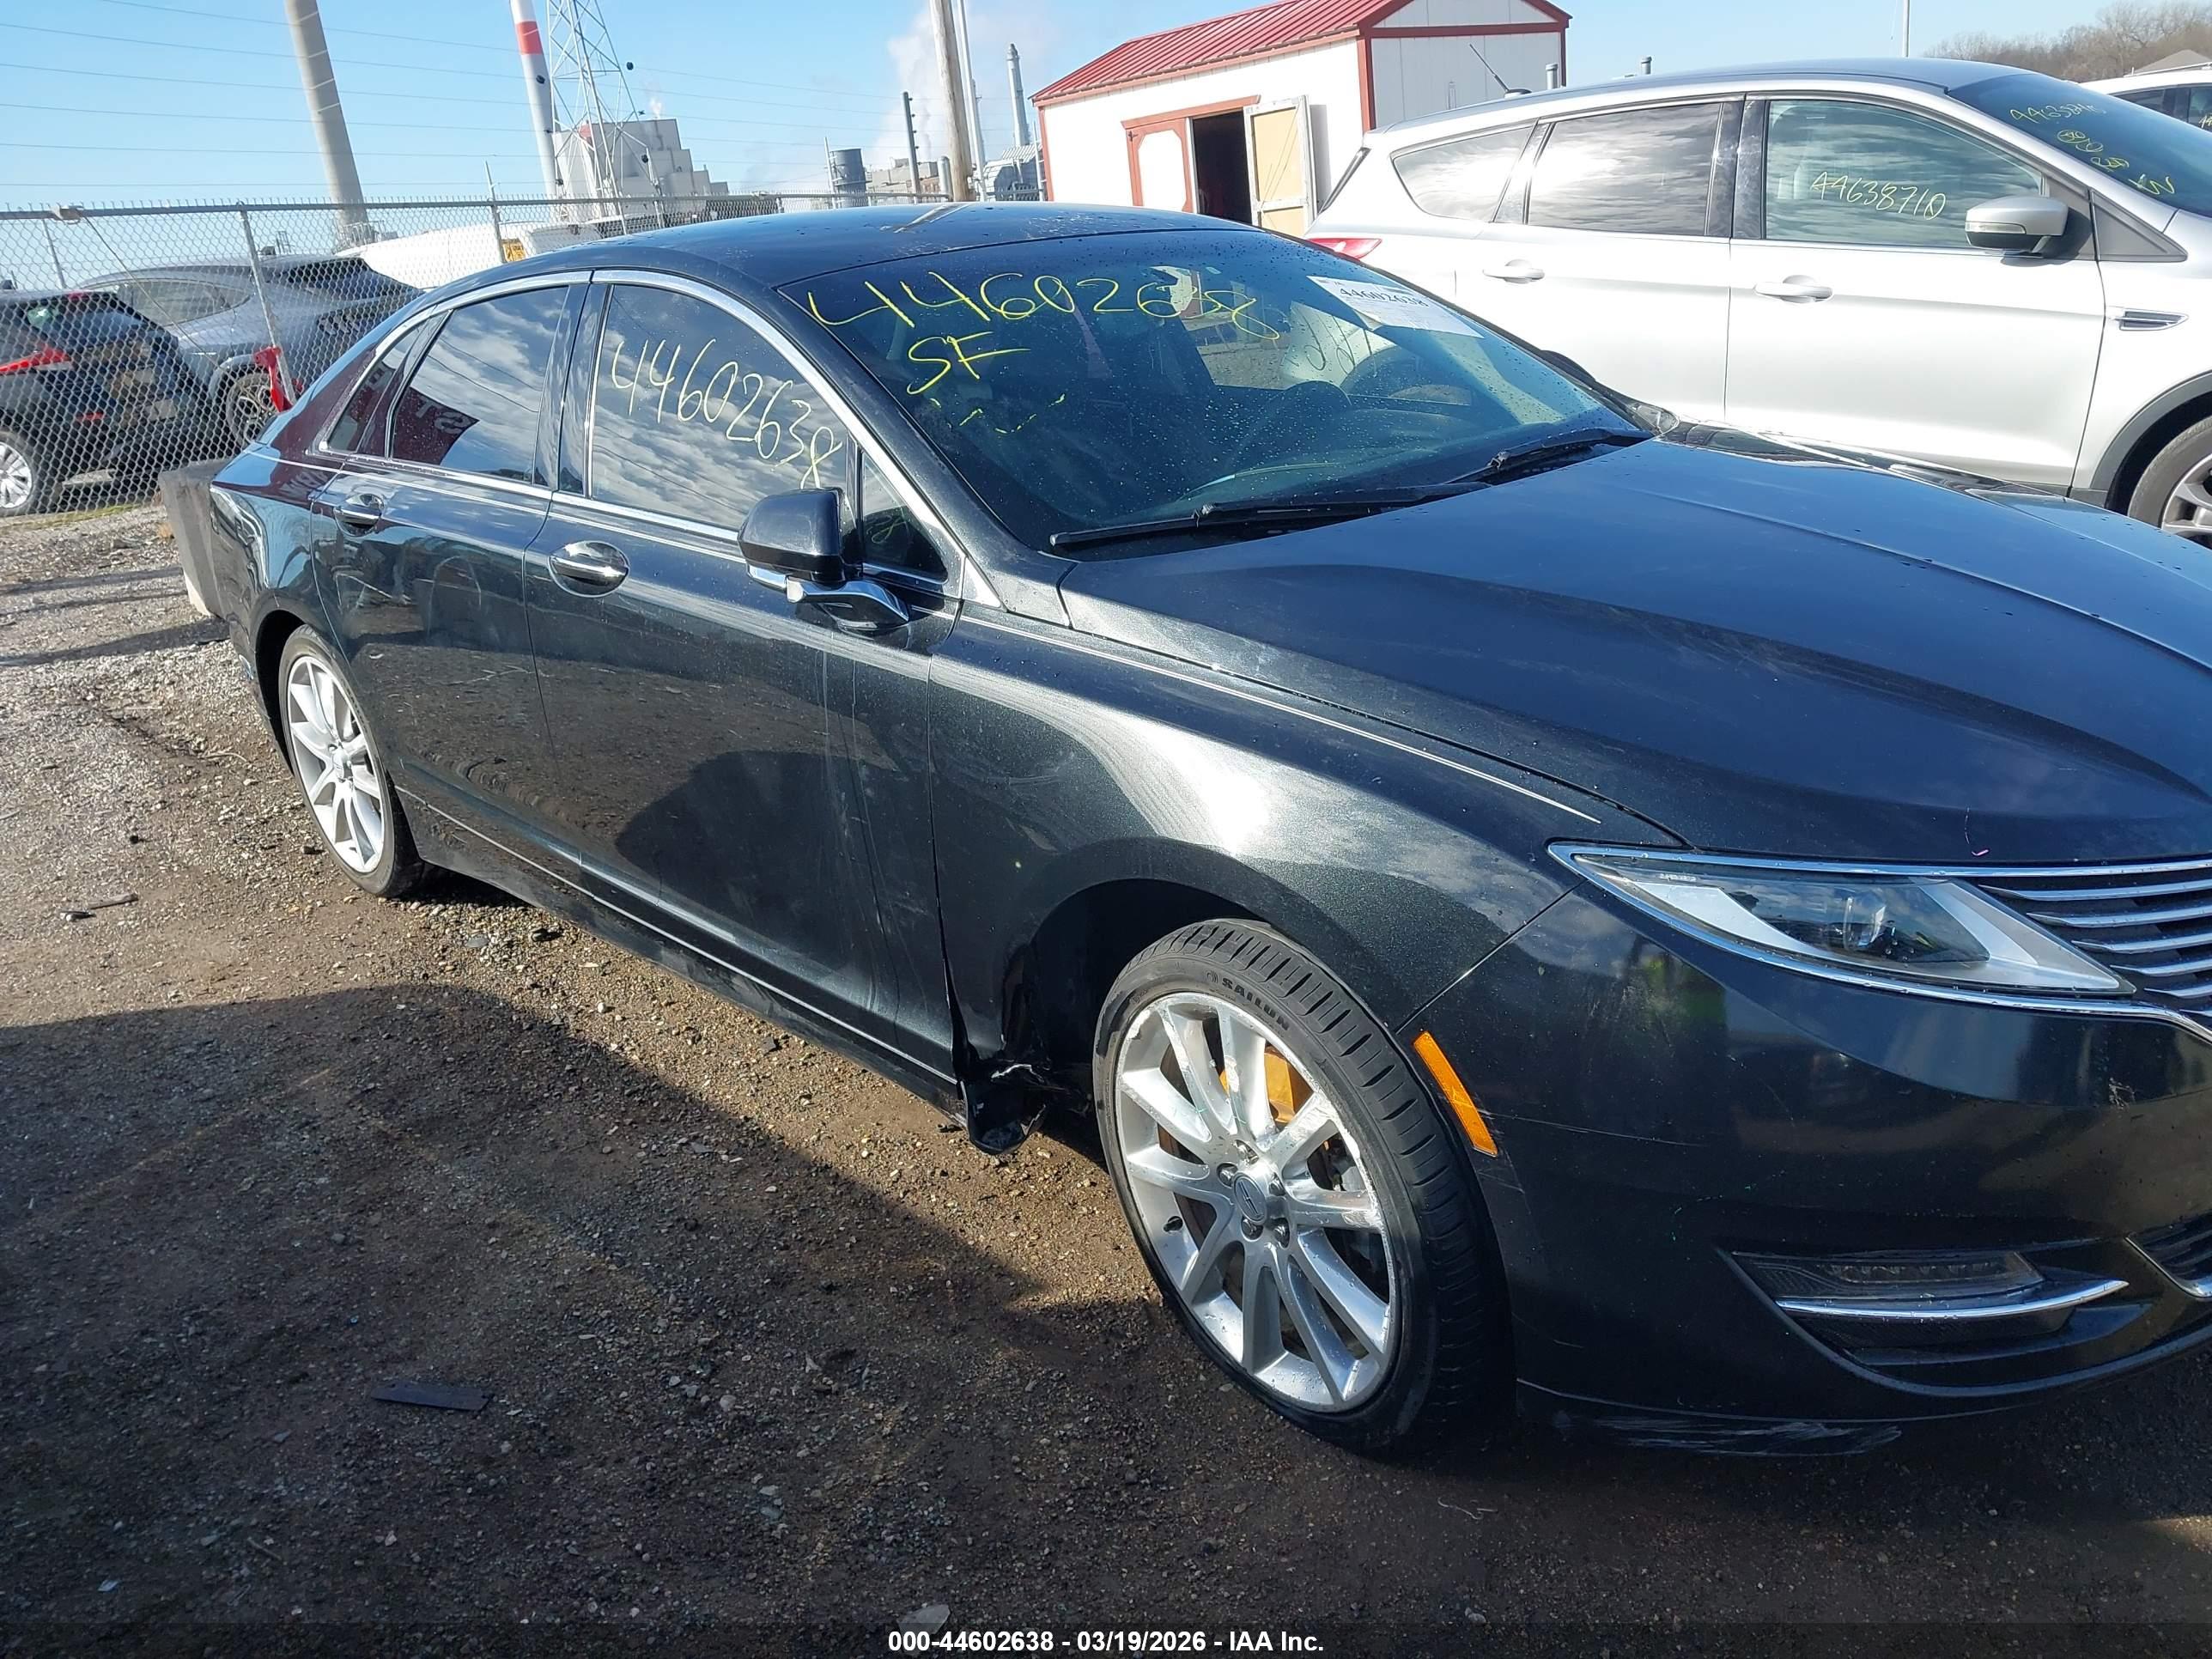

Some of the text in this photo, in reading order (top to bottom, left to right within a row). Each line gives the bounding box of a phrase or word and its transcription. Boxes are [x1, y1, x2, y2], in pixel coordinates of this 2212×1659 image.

[1809, 171, 1947, 221] 44638710
[807, 270, 1280, 340] 44602638
[906, 331, 1032, 395] SF
[611, 338, 843, 489] 44602638
[1221, 976, 1290, 1031] SAILUN
